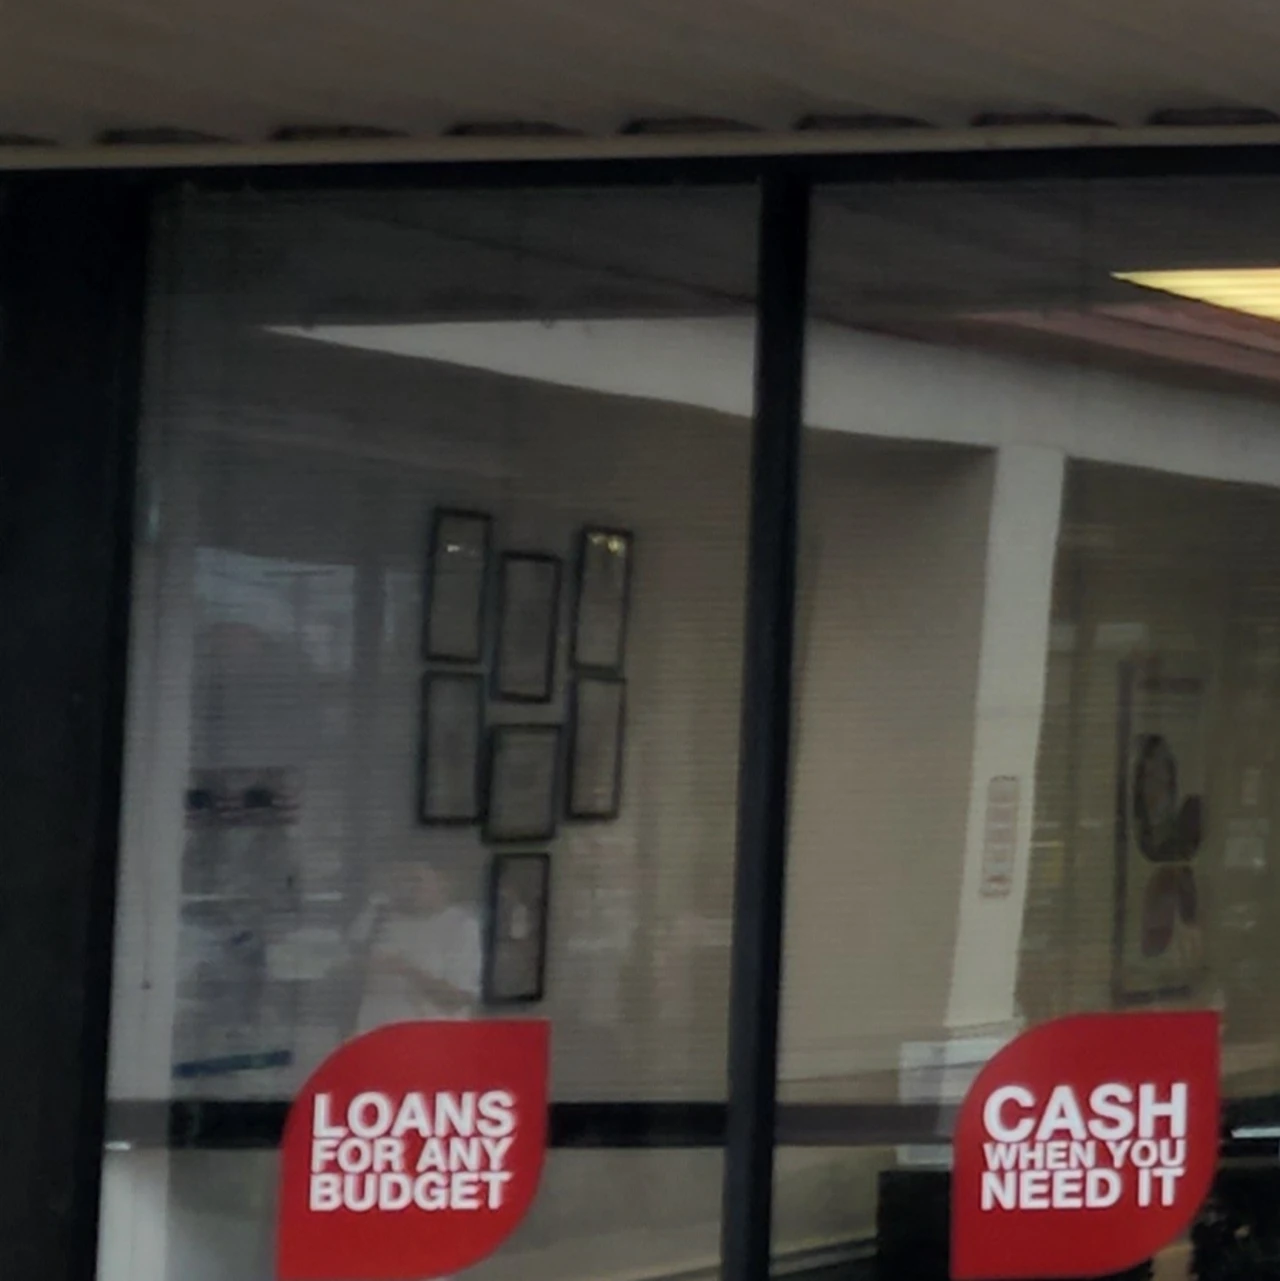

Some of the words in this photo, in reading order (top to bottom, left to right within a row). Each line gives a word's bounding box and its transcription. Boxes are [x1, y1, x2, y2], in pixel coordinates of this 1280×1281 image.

[313, 1090, 516, 1138] LOANS
[983, 1083, 1187, 1142] CASH
[311, 1137, 403, 1173] FOR
[415, 1137, 514, 1172] ANY
[983, 1141, 1096, 1170] WHEN
[1107, 1139, 1186, 1169] YOU
[309, 1172, 514, 1212] BUDGET
[981, 1169, 1122, 1210] NEED
[1138, 1168, 1185, 1207] IT
